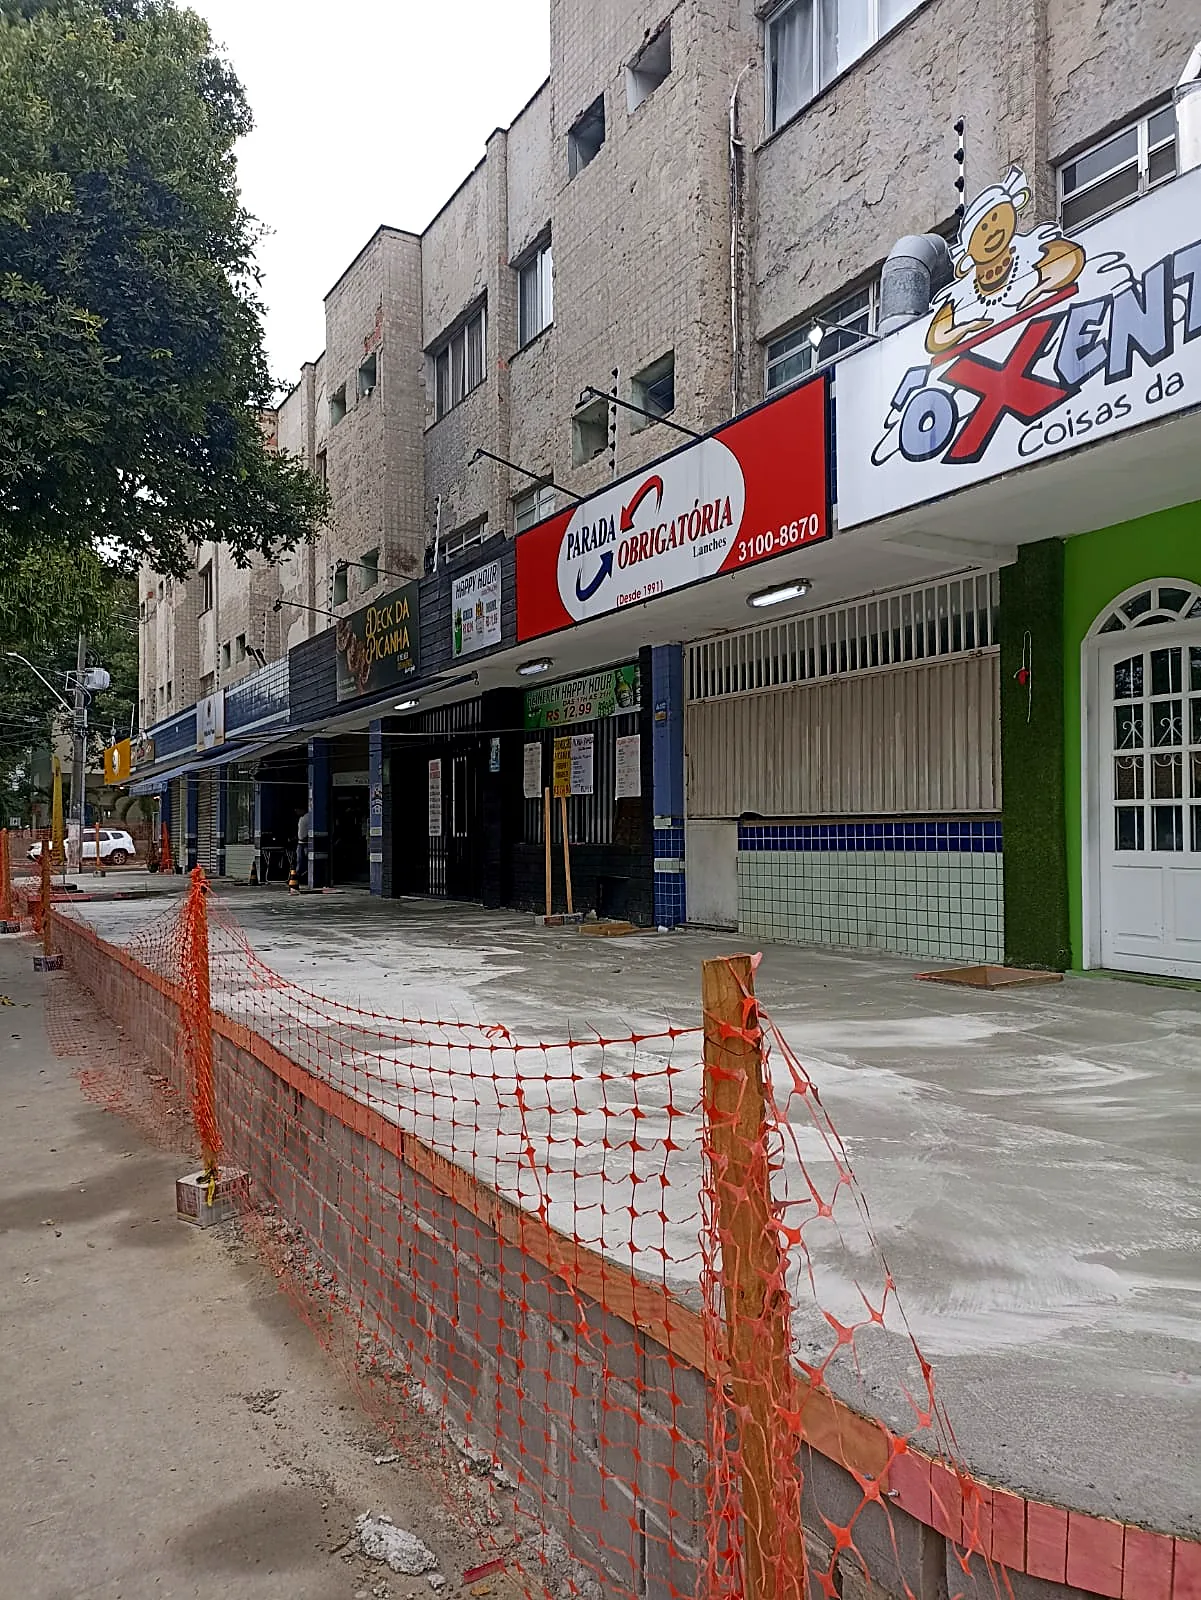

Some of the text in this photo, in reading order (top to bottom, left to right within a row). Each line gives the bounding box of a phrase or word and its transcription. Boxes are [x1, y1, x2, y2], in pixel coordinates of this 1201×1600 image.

[1018, 371, 1185, 456] Coisas da
[566, 513, 617, 561] PARADA
[617, 495, 733, 570] OBRIGATÓRIA
[692, 535, 727, 558] Lanches
[738, 512, 819, 562] 3100-8670
[456, 574, 477, 600] HAPPY
[477, 565, 497, 590] HOUR
[616, 579, 664, 608] (Desde 1991)
[366, 596, 410, 637] DECK DA
[366, 626, 410, 664] PICANHA
[561, 680, 587, 700] HAPPY
[588, 673, 612, 692] HOUR
